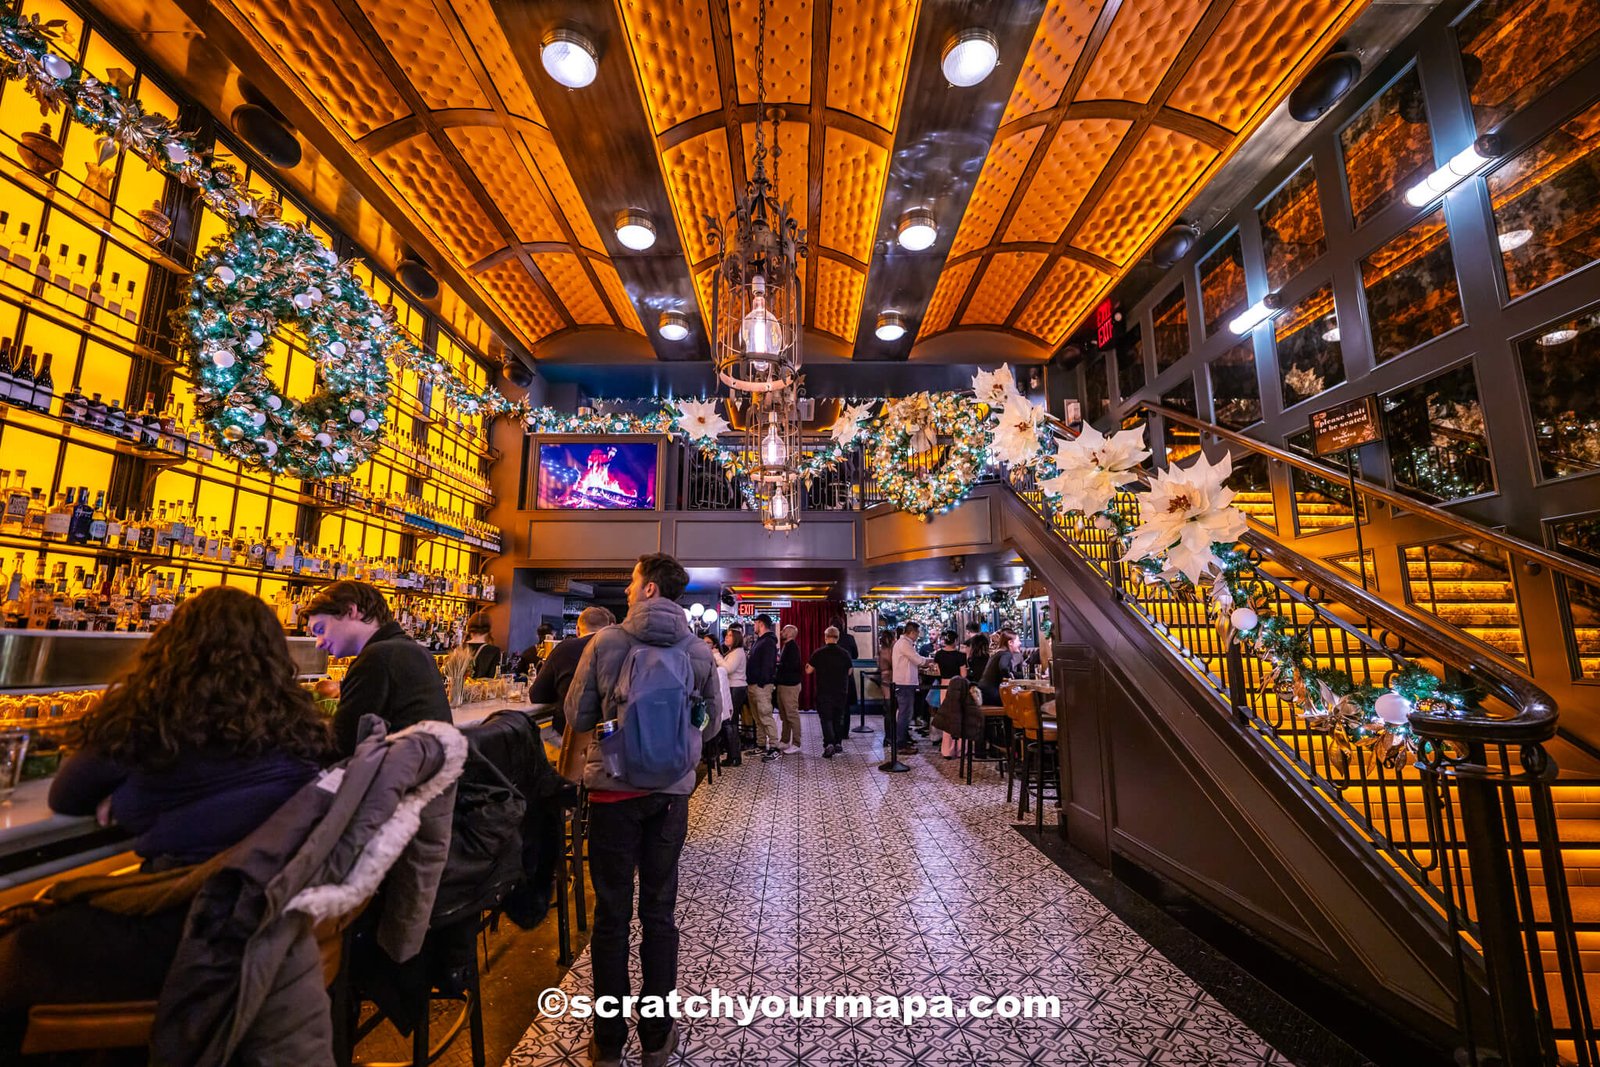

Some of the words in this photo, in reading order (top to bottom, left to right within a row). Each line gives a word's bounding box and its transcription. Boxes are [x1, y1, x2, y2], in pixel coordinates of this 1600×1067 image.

[1097, 318, 1113, 349] EXIT
[1320, 415, 1345, 428] please
[1347, 407, 1365, 418] wait
[1340, 414, 1367, 427] seated
[739, 604, 755, 615] EXIT
